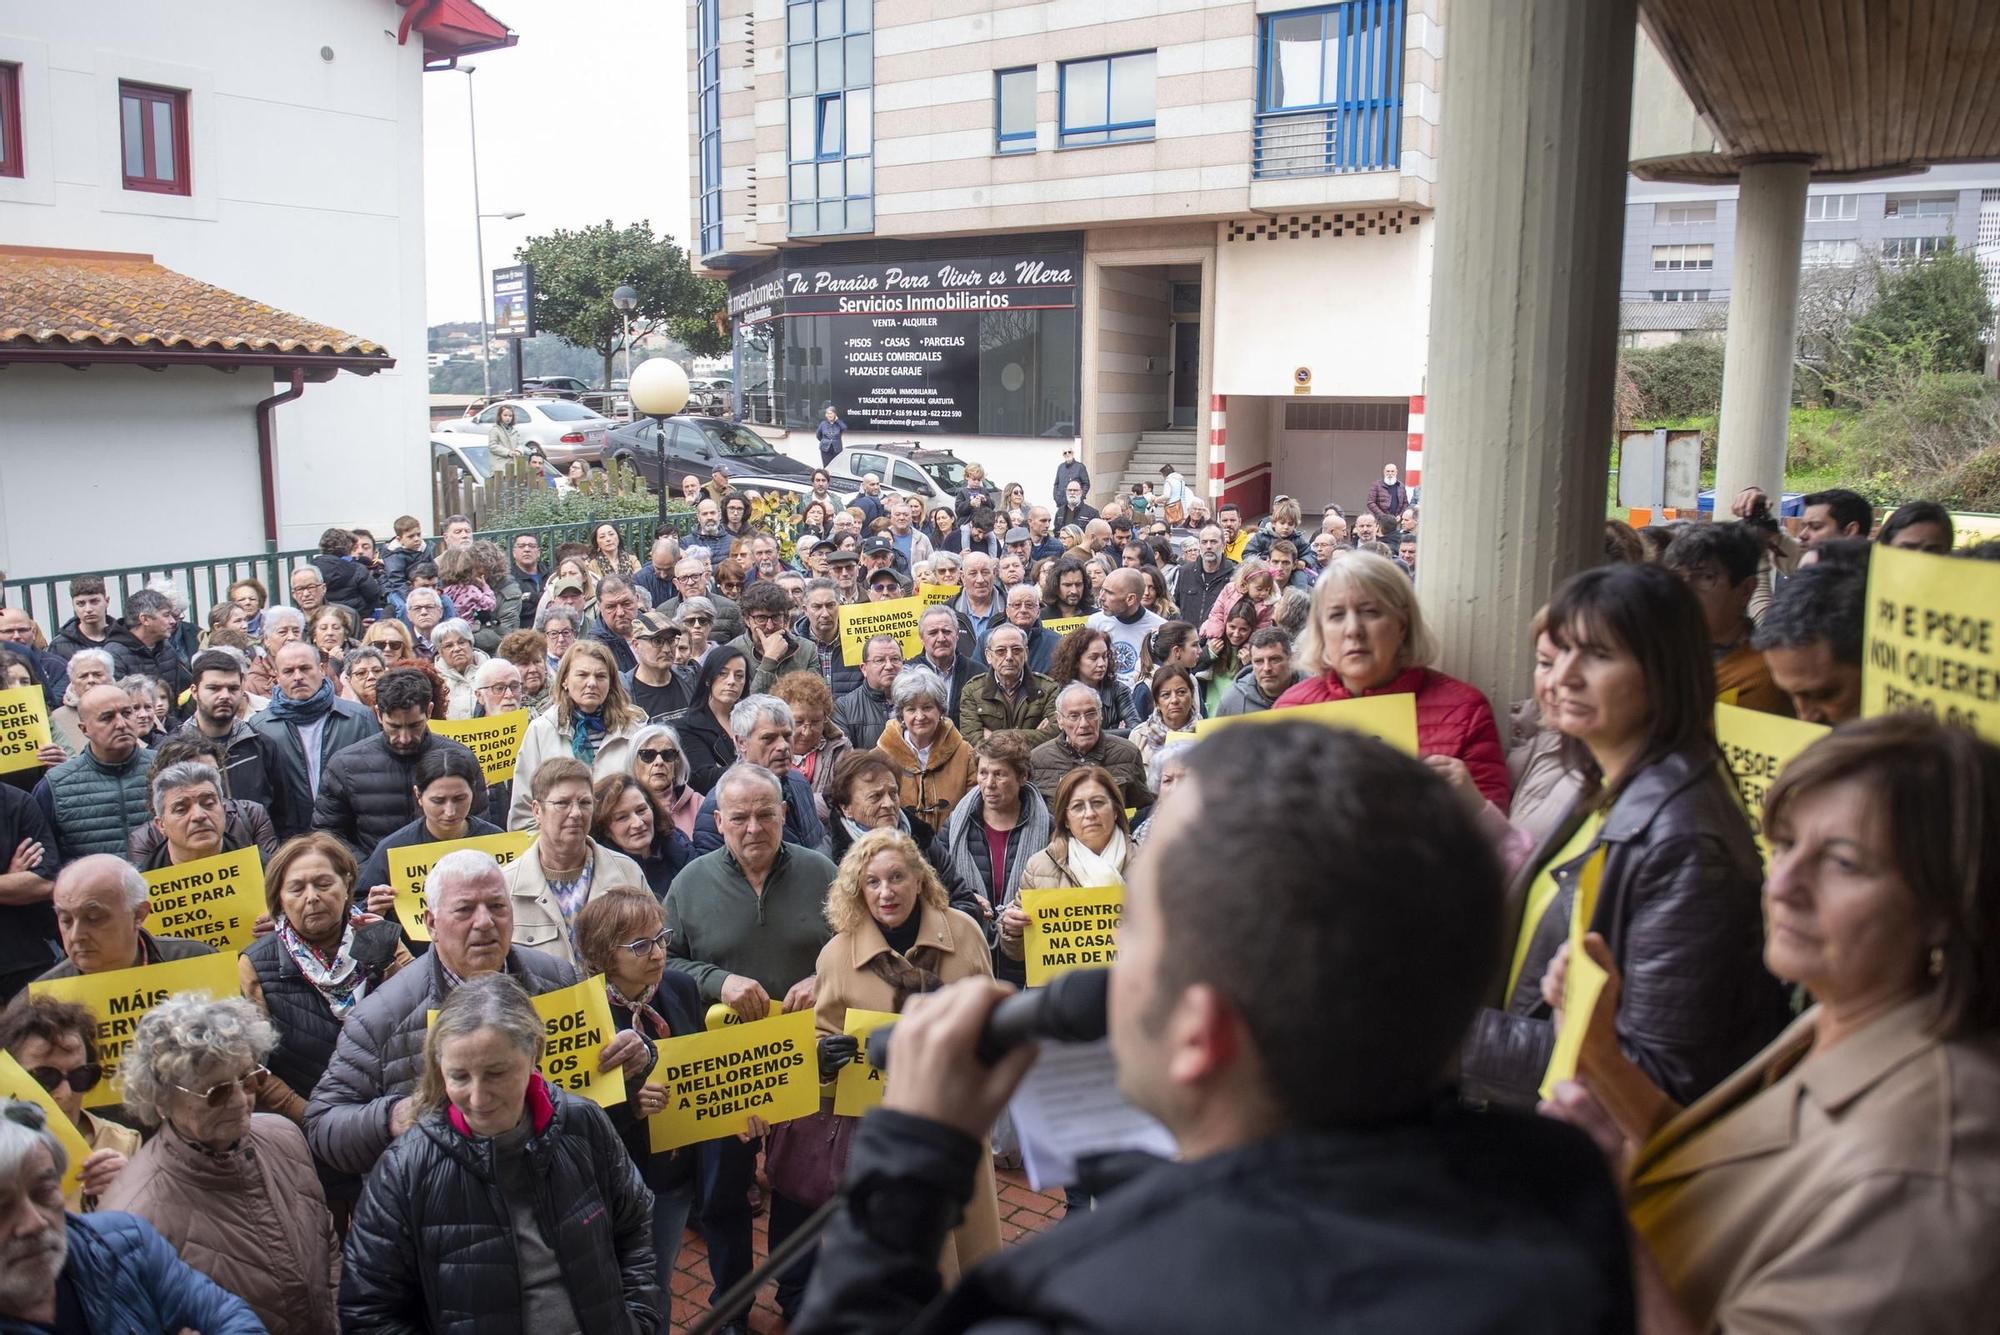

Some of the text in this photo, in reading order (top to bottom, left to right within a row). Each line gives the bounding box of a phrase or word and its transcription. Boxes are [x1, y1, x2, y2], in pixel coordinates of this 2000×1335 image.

[787, 260, 1072, 294] Tu Paraíso Para Vivir es Mera
[839, 290, 1009, 313] Servicios Inmobiliarios
[872, 318, 896, 328] VENTA
[902, 318, 938, 328] ALQUILER
[849, 337, 965, 348] PISOS CASAS PARCELAS
[849, 352, 942, 362] LOCALES COMERCIALES
[849, 366, 923, 376] PLAZAS DE GARAJE
[889, 397, 926, 405] PROFESIONAL
[850, 611, 913, 626] DEFENDAMOS
[846, 619, 919, 635] E MELLOREMOS
[1056, 623, 1086, 632] CENTRO
[1903, 605, 1917, 637] E
[1924, 608, 1994, 654] PSOE
[7, 729, 28, 741] OS
[453, 729, 500, 743] CENTRO
[502, 724, 517, 733] DE
[24, 739, 39, 751] SI
[480, 736, 515, 752] DIGNO
[496, 748, 512, 760] DO
[487, 757, 517, 774] MERA
[406, 864, 428, 878] UN
[495, 851, 514, 865] DE
[149, 865, 240, 897] CENTRO DE
[191, 884, 236, 905] PARA
[161, 908, 213, 928] DEXO,
[1038, 903, 1124, 919] UN CENTRO
[229, 917, 240, 929] E
[1042, 918, 1093, 934] SAÚDE
[1049, 934, 1115, 949] NA CASA
[1042, 952, 1077, 966] MAR
[1081, 950, 1102, 963] DE
[109, 988, 170, 1015] MÁIS
[548, 1054, 578, 1075] OS
[666, 1038, 794, 1082] DEFENDAMOS
[568, 1070, 591, 1090] SI
[677, 1053, 805, 1096] MELLOREMOS
[868, 1069, 880, 1081] A
[678, 1072, 789, 1110] A SANIDADE
[695, 1092, 774, 1121] PÚBLICA
